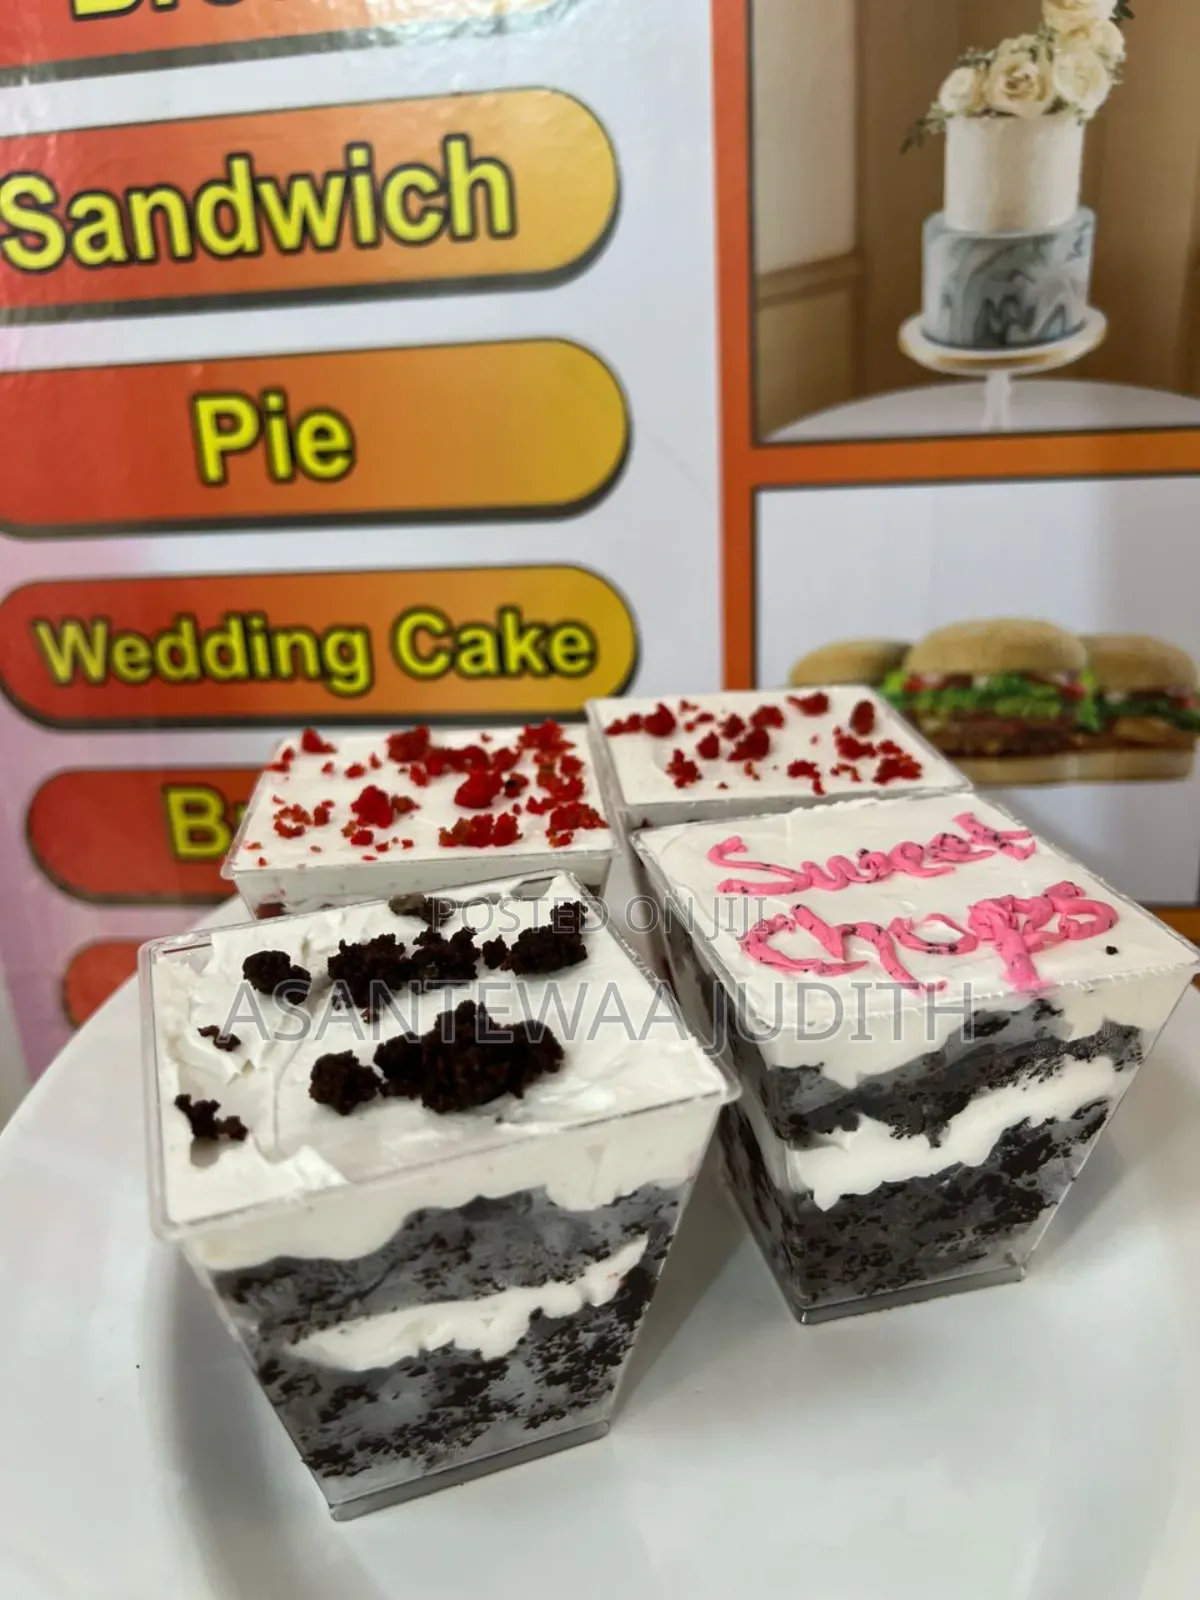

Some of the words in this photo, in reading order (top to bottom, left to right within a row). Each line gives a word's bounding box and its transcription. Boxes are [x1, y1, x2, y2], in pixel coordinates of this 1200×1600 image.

[0, 133, 517, 273] Sandwich
[191, 388, 355, 484] Pie
[34, 612, 372, 694] Wedding
[392, 606, 598, 678] Cake
